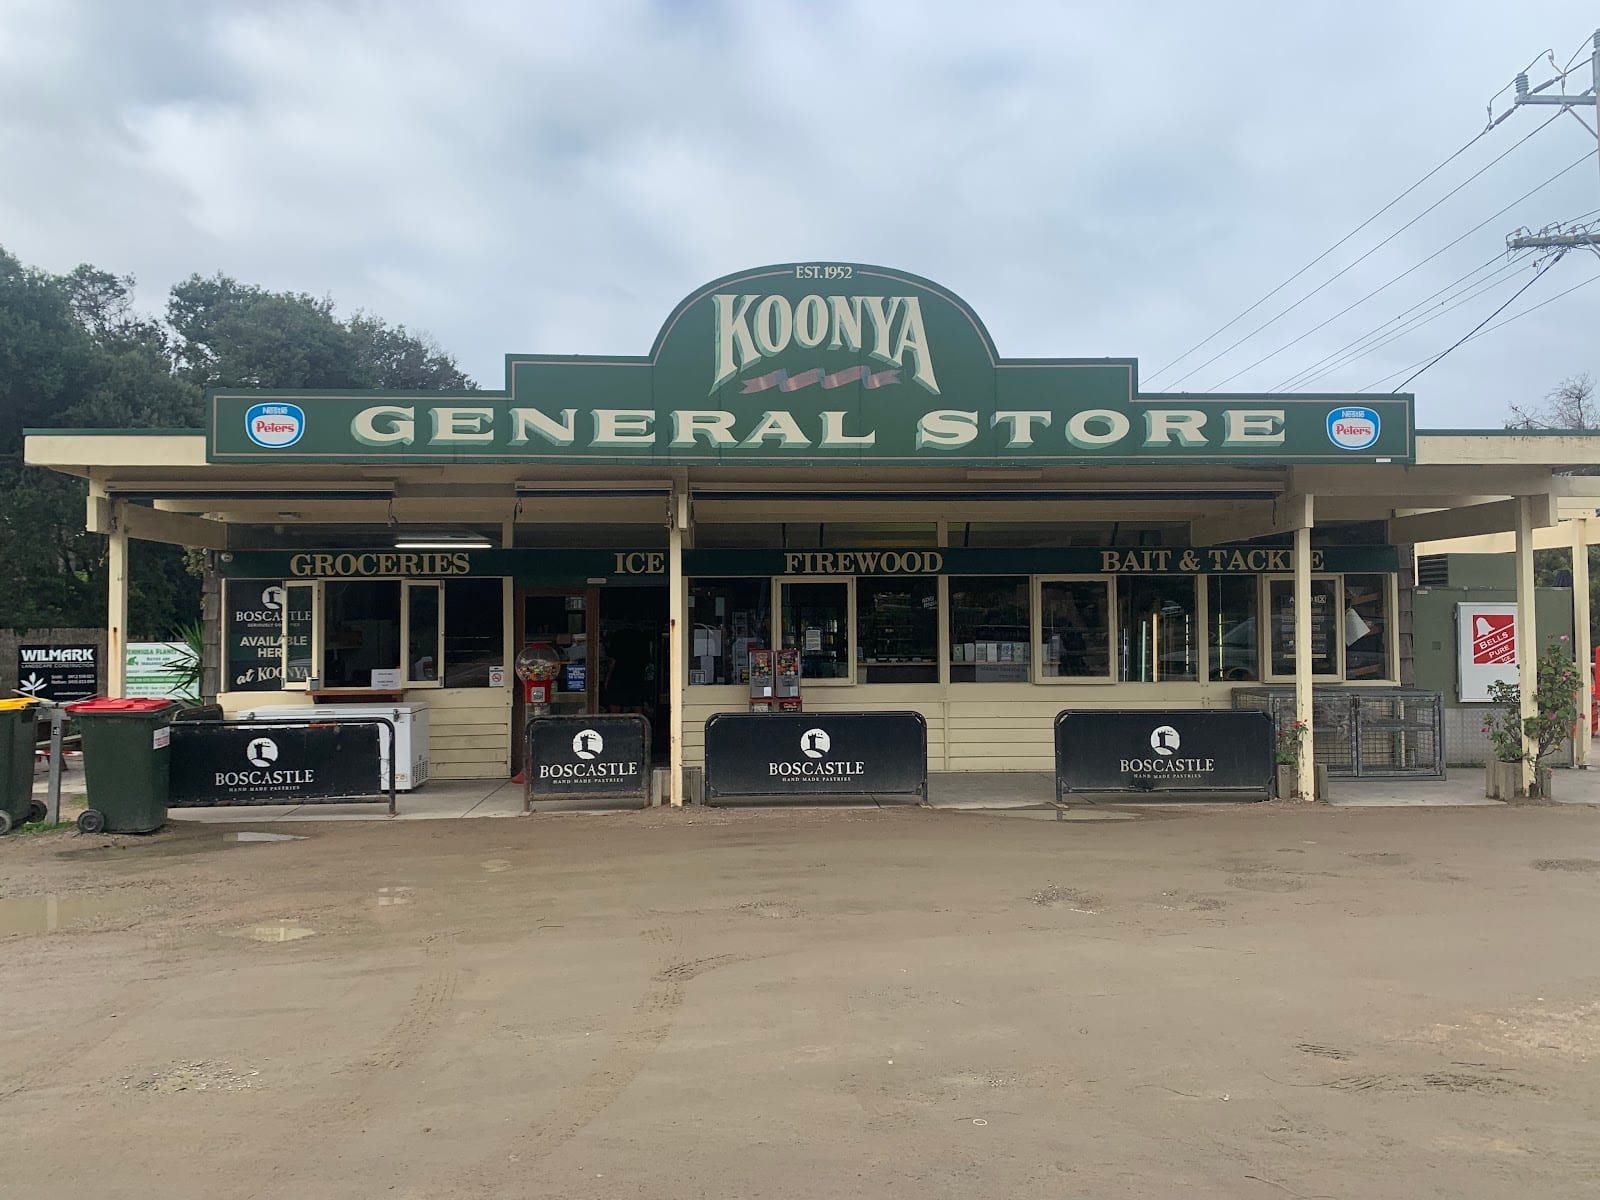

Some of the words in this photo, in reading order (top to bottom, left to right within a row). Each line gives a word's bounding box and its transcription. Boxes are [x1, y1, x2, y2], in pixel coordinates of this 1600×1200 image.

[708, 293, 942, 397] KOONYA
[256, 420, 295, 433] Peters
[350, 405, 876, 449] GENERAL
[915, 408, 1286, 450] STORE
[1335, 423, 1372, 436] Peters
[289, 552, 471, 576] GROCERIES
[613, 552, 665, 574] ICE
[783, 551, 943, 574] FIREWOOD
[1100, 550, 1172, 572] BAIT
[1179, 550, 1200, 571] &
[236, 610, 312, 622] BOSCATLE
[1479, 631, 1509, 650] BELLS
[21, 648, 94, 662] WILMARK
[1488, 645, 1511, 659] PURE
[236, 669, 255, 685] at
[540, 761, 638, 778] BOSCASTLE
[768, 761, 865, 776] BOSCASTLE
[1119, 758, 1215, 772] BOSCASTLE
[215, 769, 315, 786] BOSCASTLE
